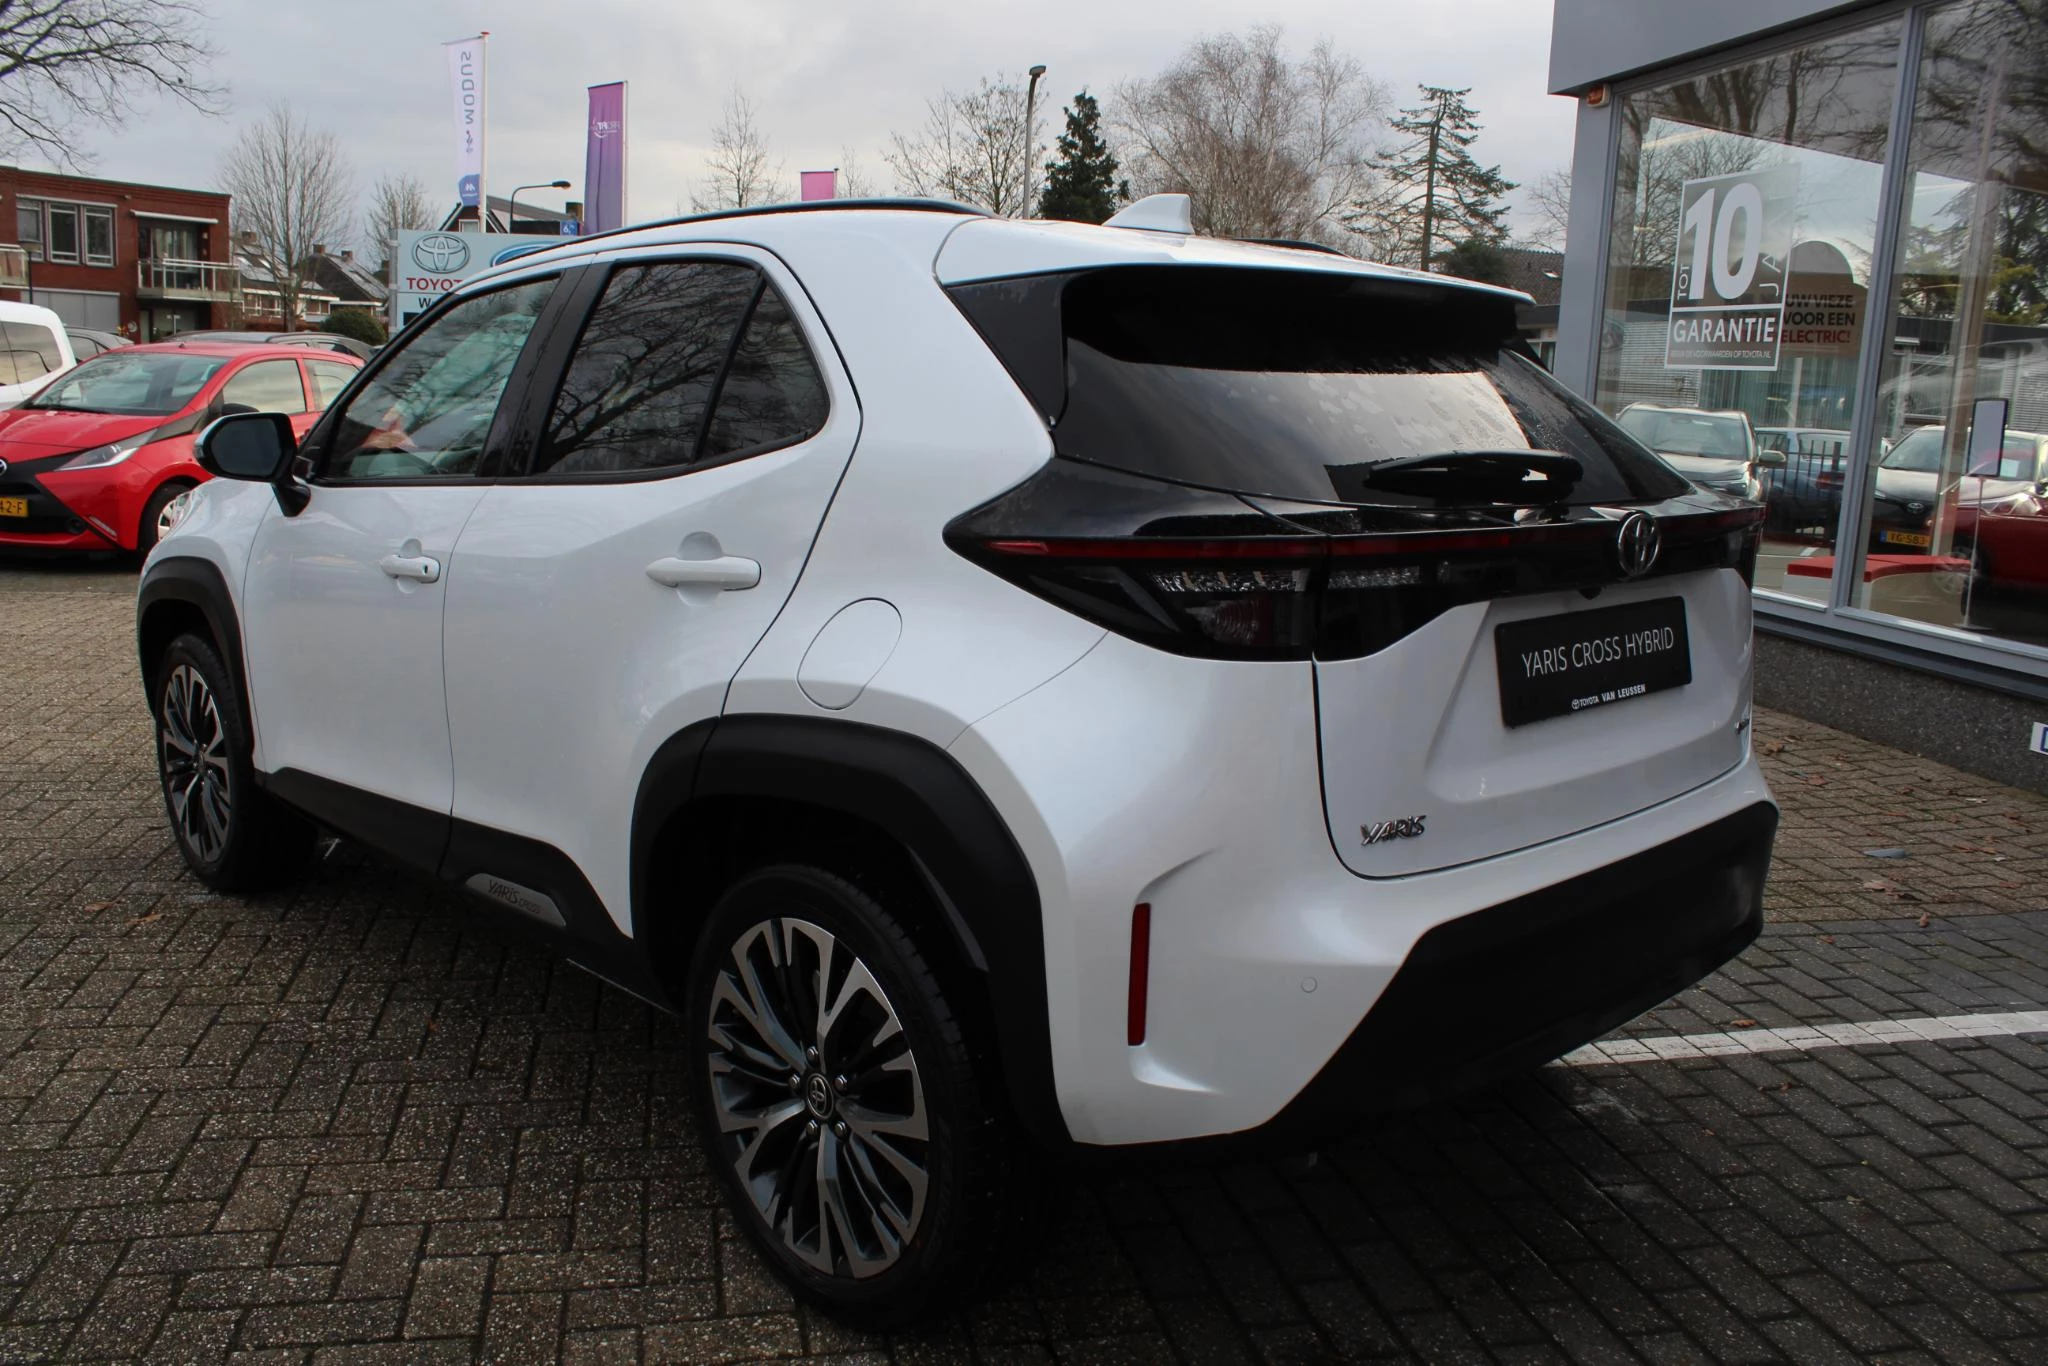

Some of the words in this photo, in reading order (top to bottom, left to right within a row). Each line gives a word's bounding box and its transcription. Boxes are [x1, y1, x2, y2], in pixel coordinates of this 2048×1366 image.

[1683, 182, 1763, 299] 10
[406, 277, 463, 291] TOYOT
[1677, 264, 1690, 300] TOT
[1812, 294, 1854, 308] VIEZE
[1673, 317, 1775, 343] GARANTIE
[1783, 312, 1825, 326] VOOR
[1828, 312, 1856, 326] EEN
[1781, 330, 1850, 343] ELECTRIC!
[1522, 646, 1568, 678] YARIS
[1572, 636, 1622, 668] CROSS
[1625, 627, 1674, 657] HYBRID
[1580, 696, 1600, 707] TOYOTA
[1601, 691, 1616, 702] VAN
[1618, 683, 1646, 698] LEUSSEN
